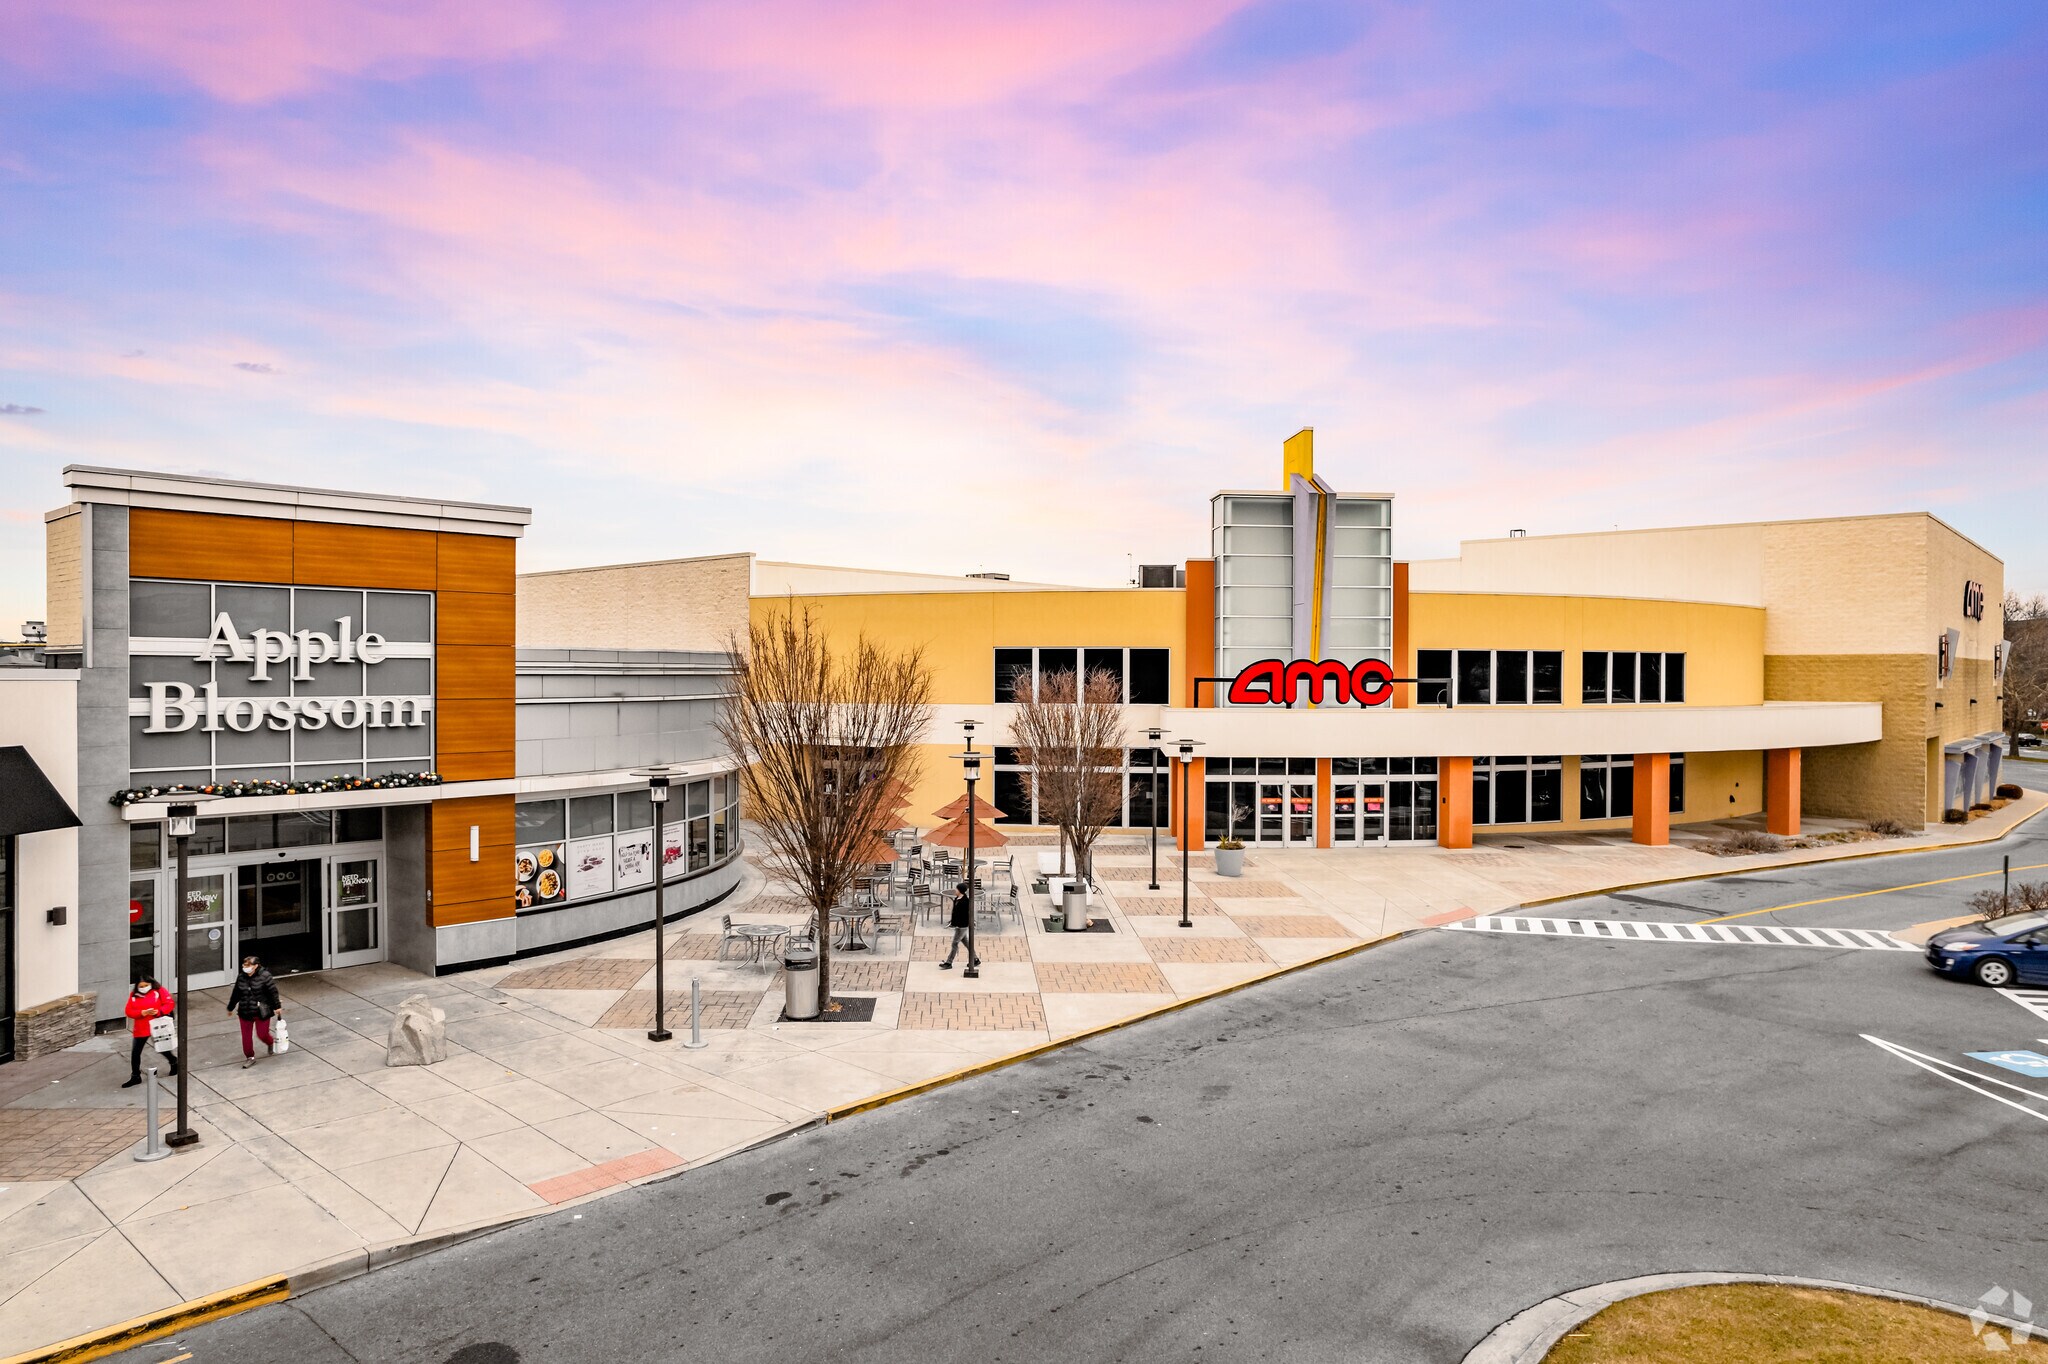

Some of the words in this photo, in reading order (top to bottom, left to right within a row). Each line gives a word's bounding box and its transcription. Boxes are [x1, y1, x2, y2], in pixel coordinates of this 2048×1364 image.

[193, 611, 386, 681] Apple
[142, 681, 426, 733] Blossom
[187, 890, 201, 898] EED
[193, 894, 218, 902] KNOW
